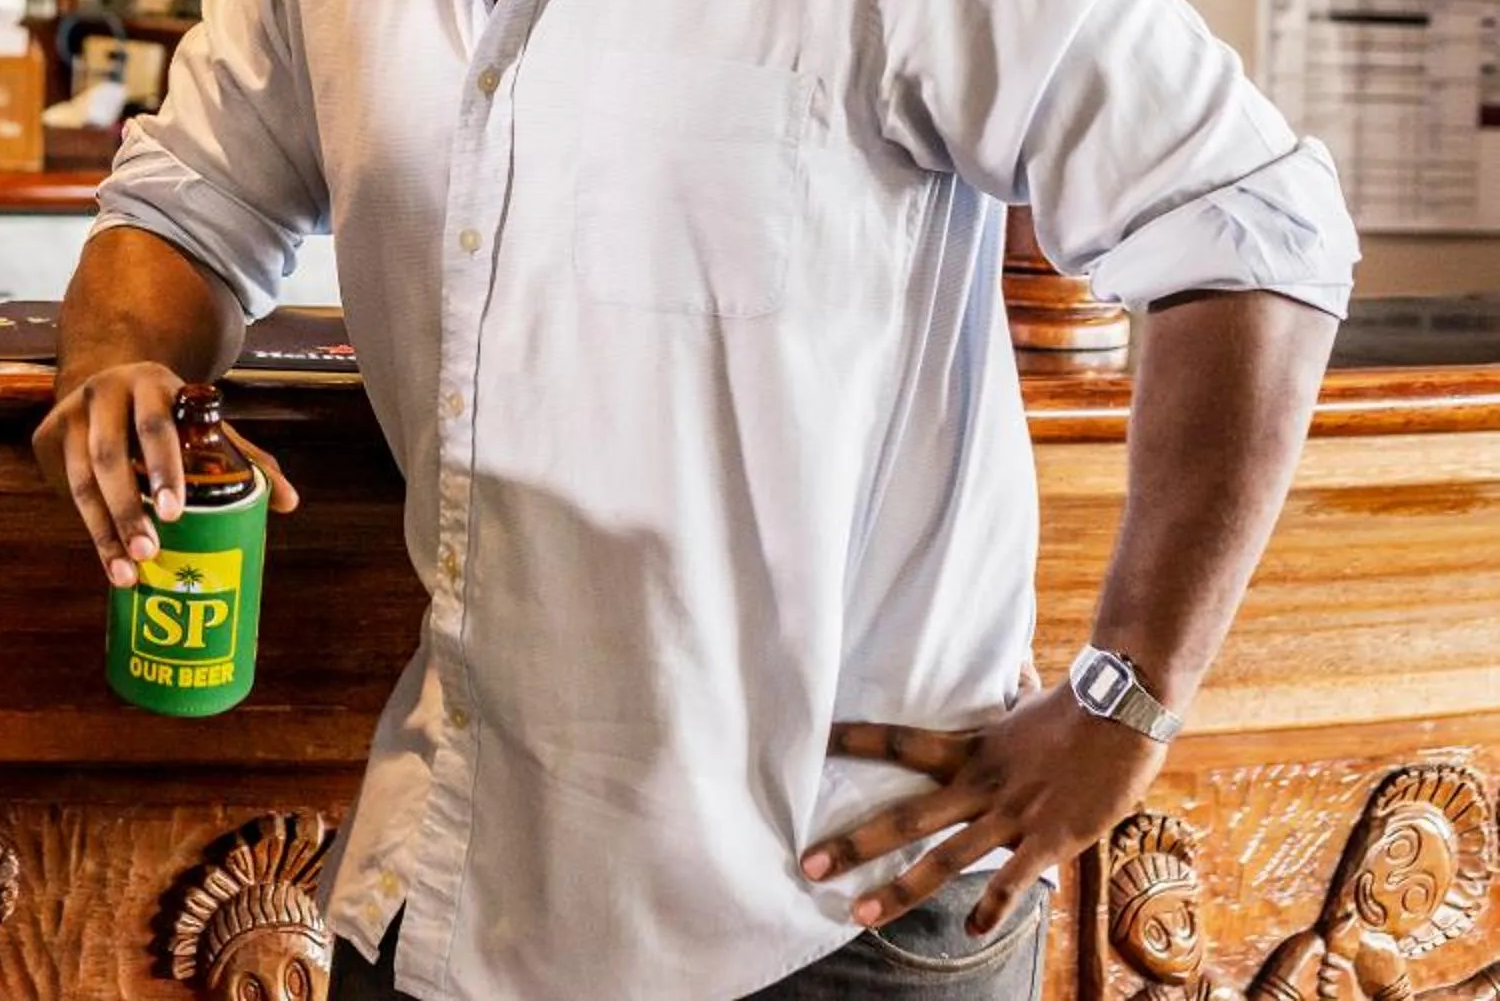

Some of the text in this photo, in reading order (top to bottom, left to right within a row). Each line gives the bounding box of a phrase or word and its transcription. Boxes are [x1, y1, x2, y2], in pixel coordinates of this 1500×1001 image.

[143, 596, 229, 648] SP
[130, 656, 235, 688] OUR BEER
